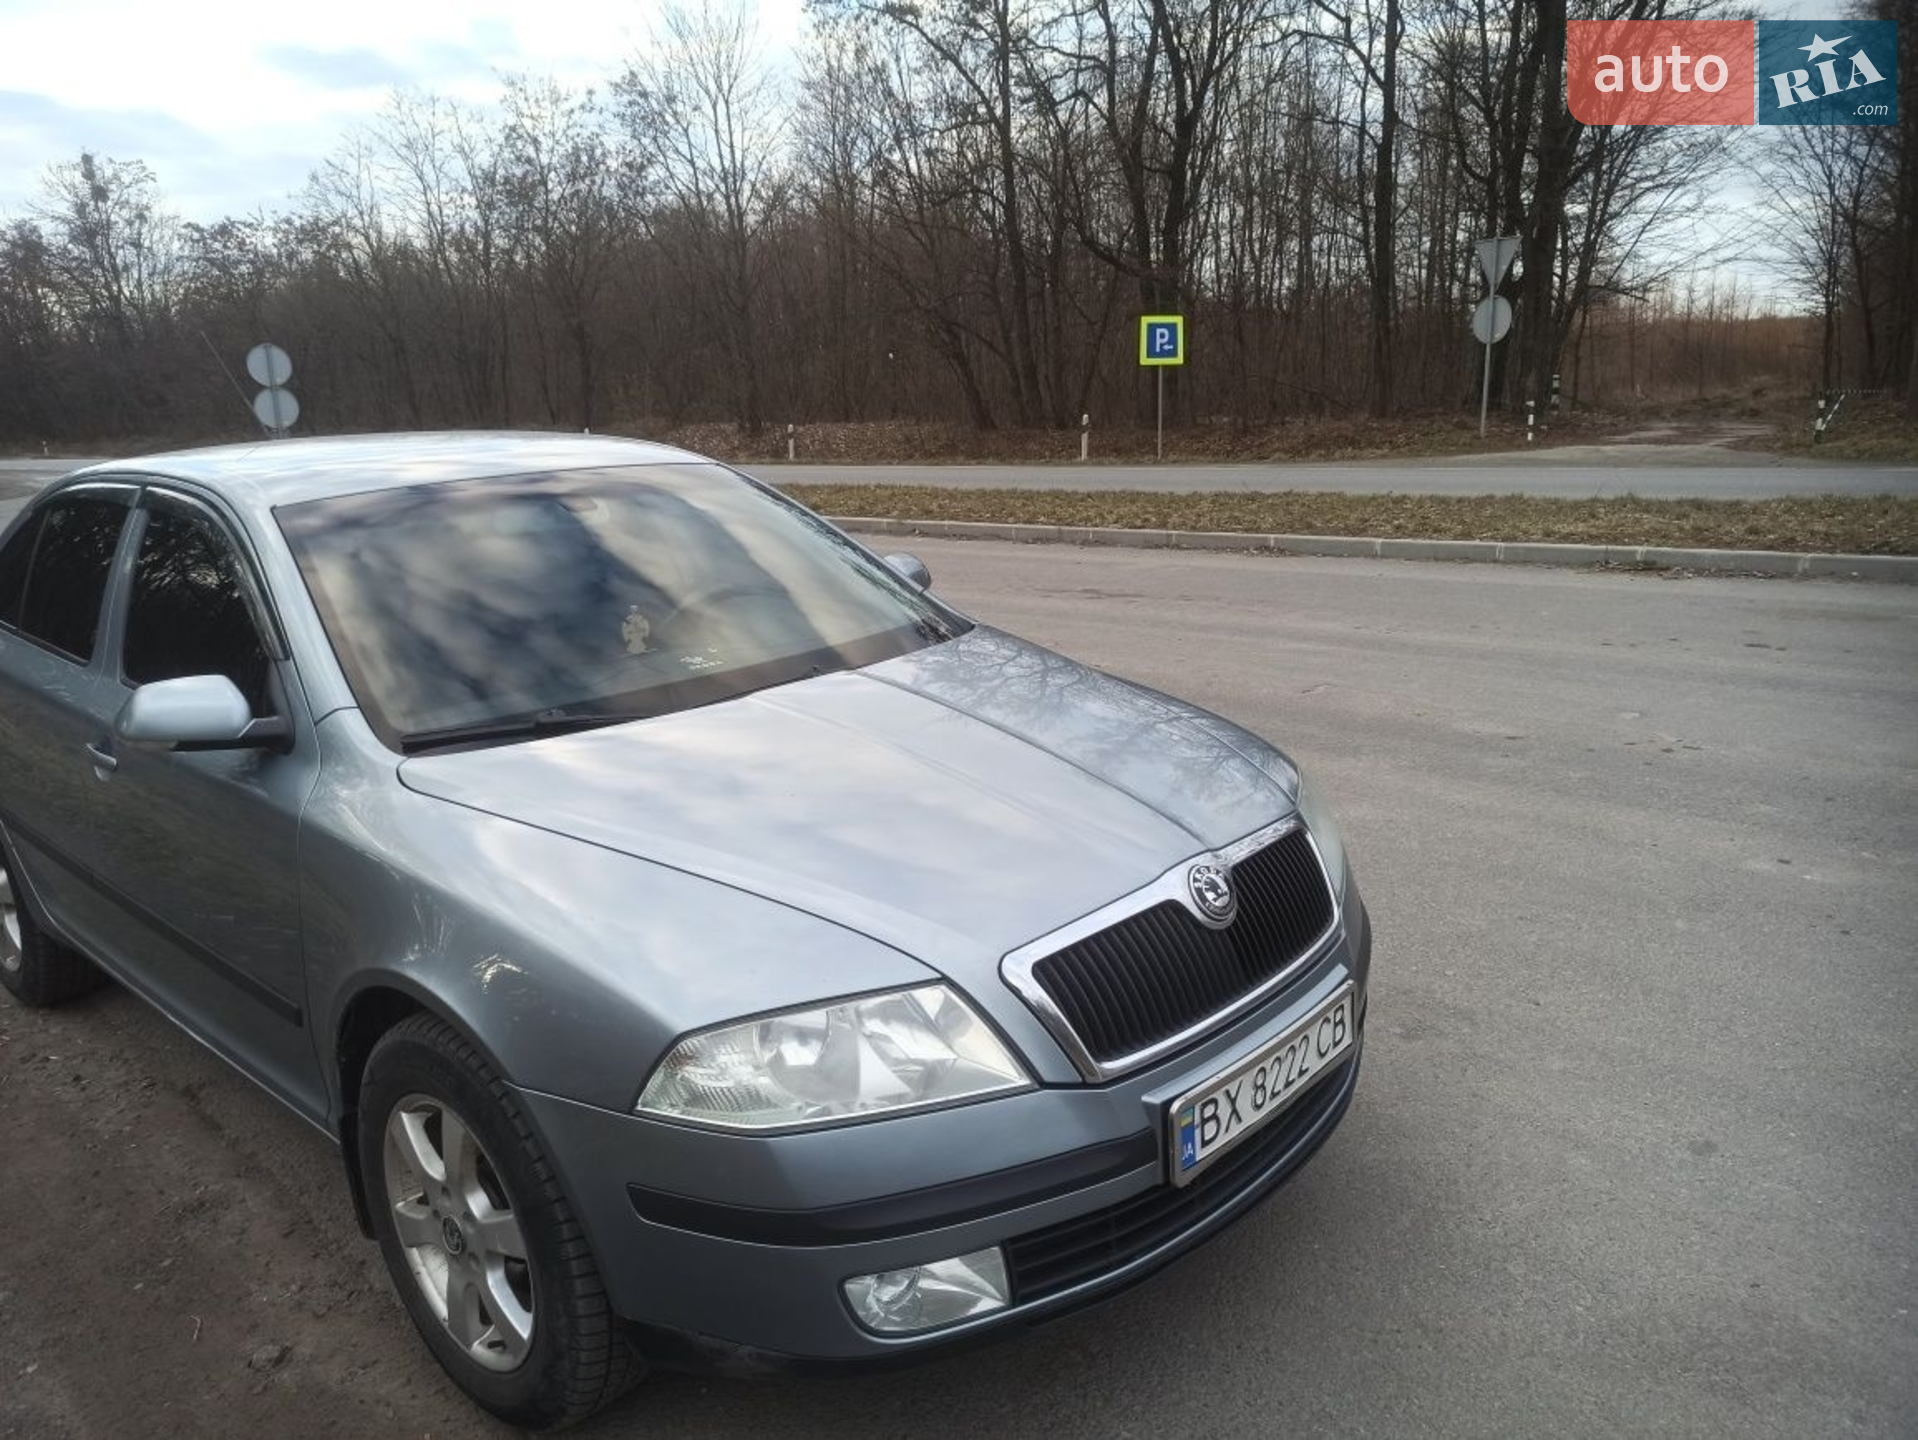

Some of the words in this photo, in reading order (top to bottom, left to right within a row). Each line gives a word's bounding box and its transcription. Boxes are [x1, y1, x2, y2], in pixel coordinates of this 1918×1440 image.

[1155, 327, 1170, 353] P
[1200, 1079, 1244, 1149] BX
[1252, 1034, 1310, 1112] 8222
[1316, 1003, 1346, 1060] CB
